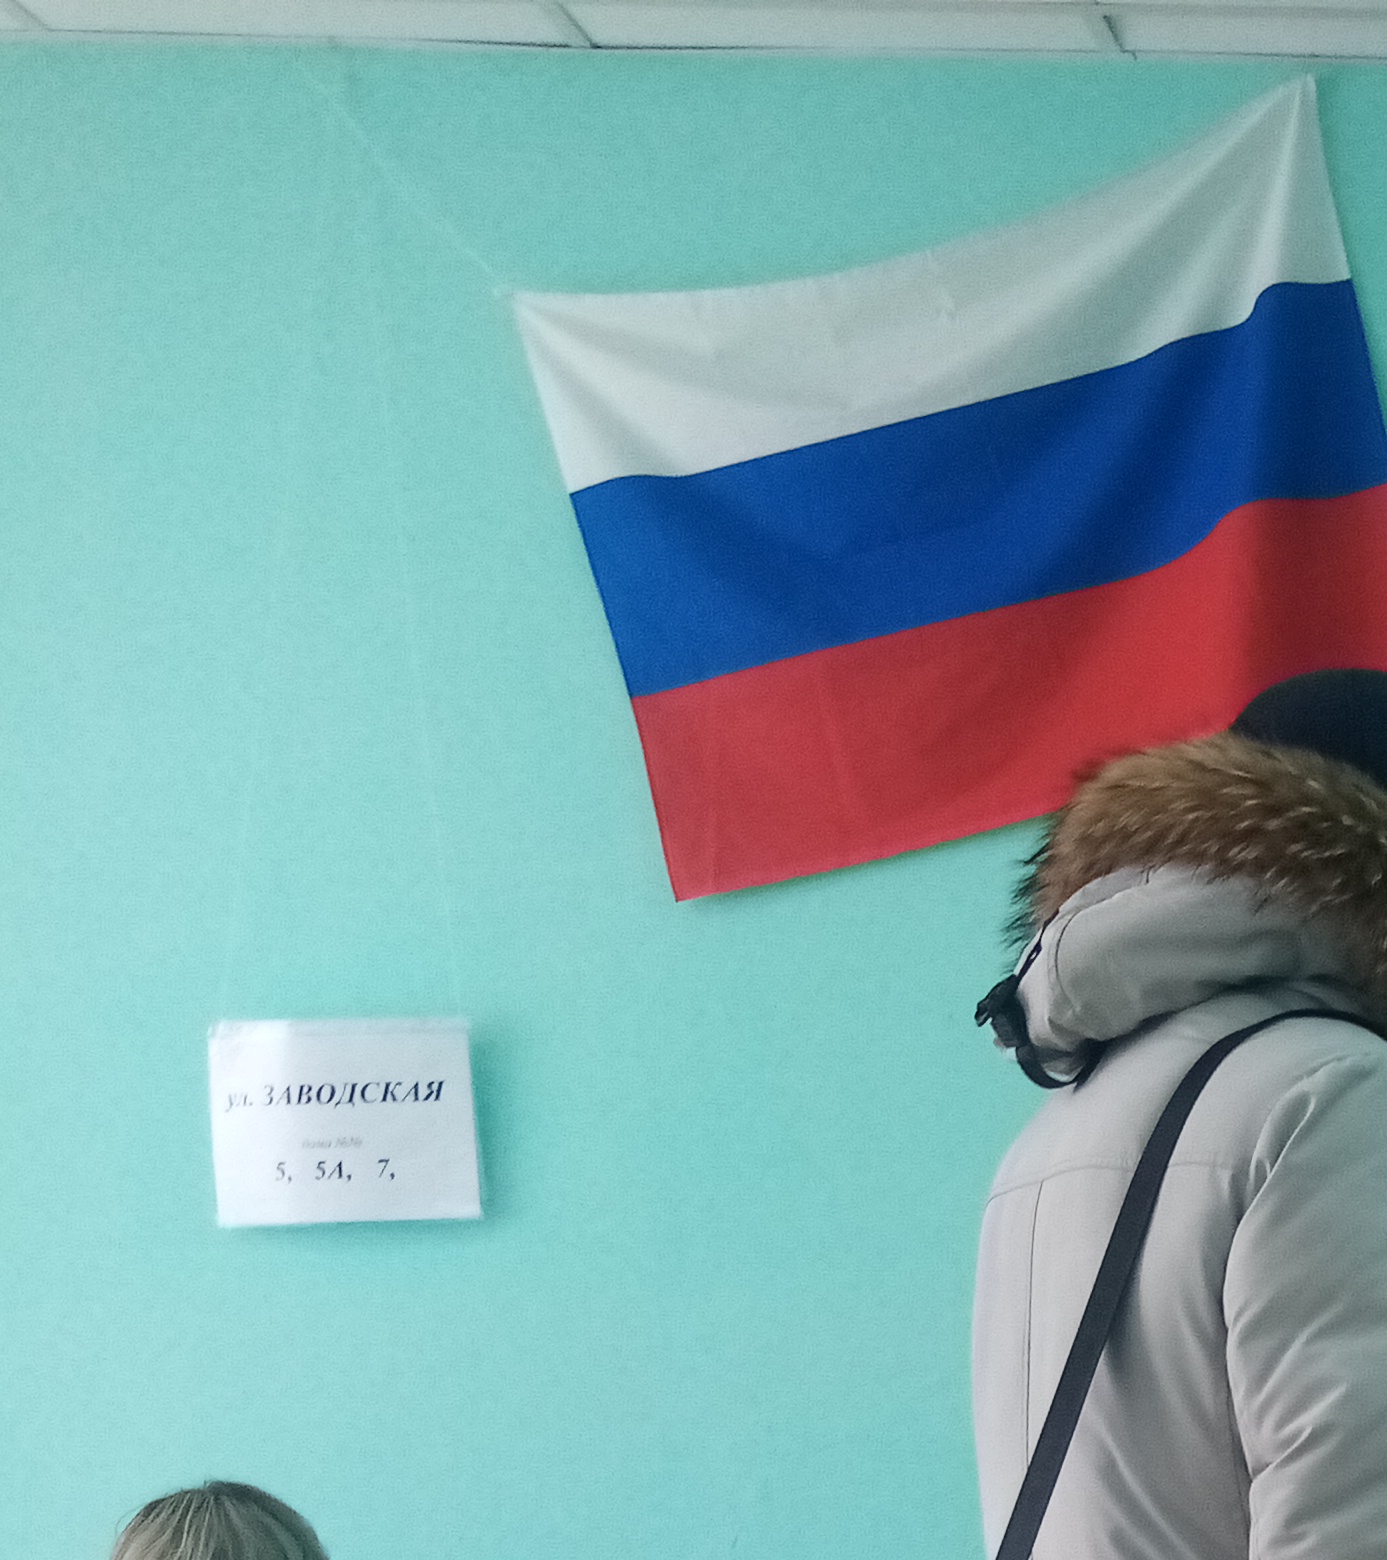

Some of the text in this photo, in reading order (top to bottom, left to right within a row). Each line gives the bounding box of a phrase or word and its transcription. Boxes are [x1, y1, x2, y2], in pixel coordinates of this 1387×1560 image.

[225, 1078, 446, 1113] ул. ЗАВОДСКАЯ
[275, 1158, 397, 1184] 5, 5А, 7,
